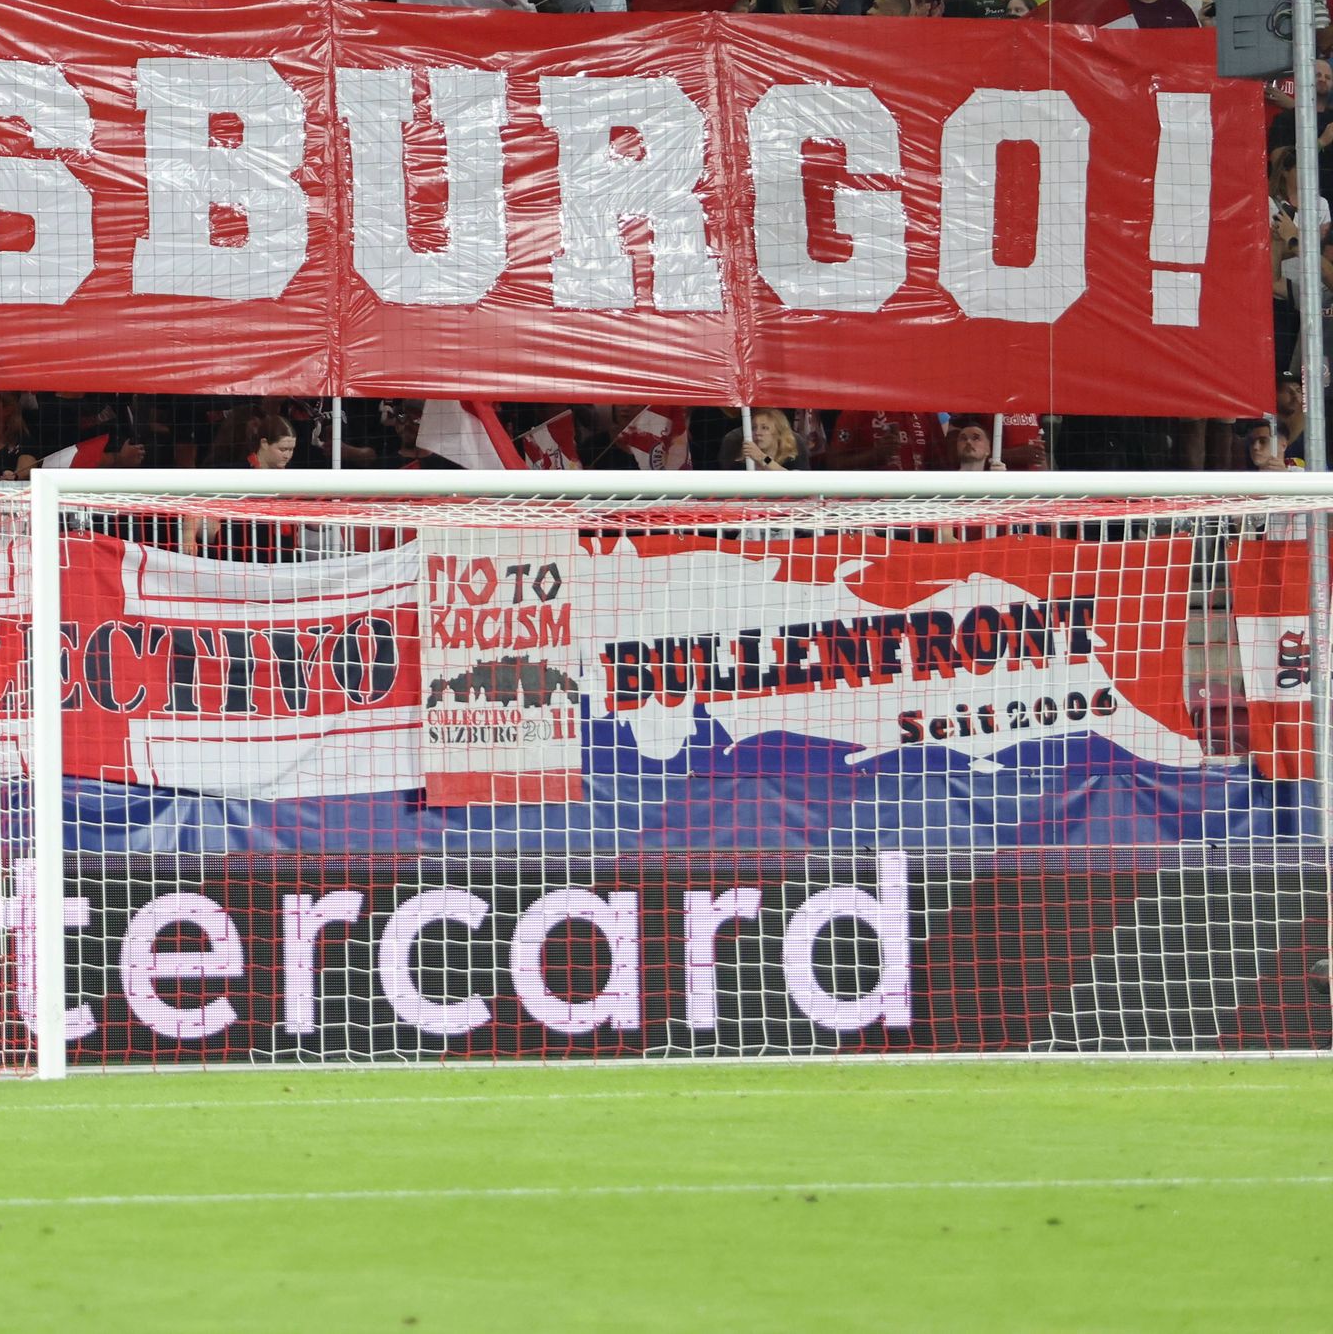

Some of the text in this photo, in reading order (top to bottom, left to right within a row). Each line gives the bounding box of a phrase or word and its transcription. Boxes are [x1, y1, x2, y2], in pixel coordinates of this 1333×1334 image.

[426, 555, 563, 606] NO TO
[429, 602, 573, 651] RACISM
[599, 594, 1095, 712] BULLENFRONT
[427, 709, 522, 726] COLLECTIVO
[429, 726, 518, 743] SALZBURG
[898, 687, 1119, 744] Seit 2006
